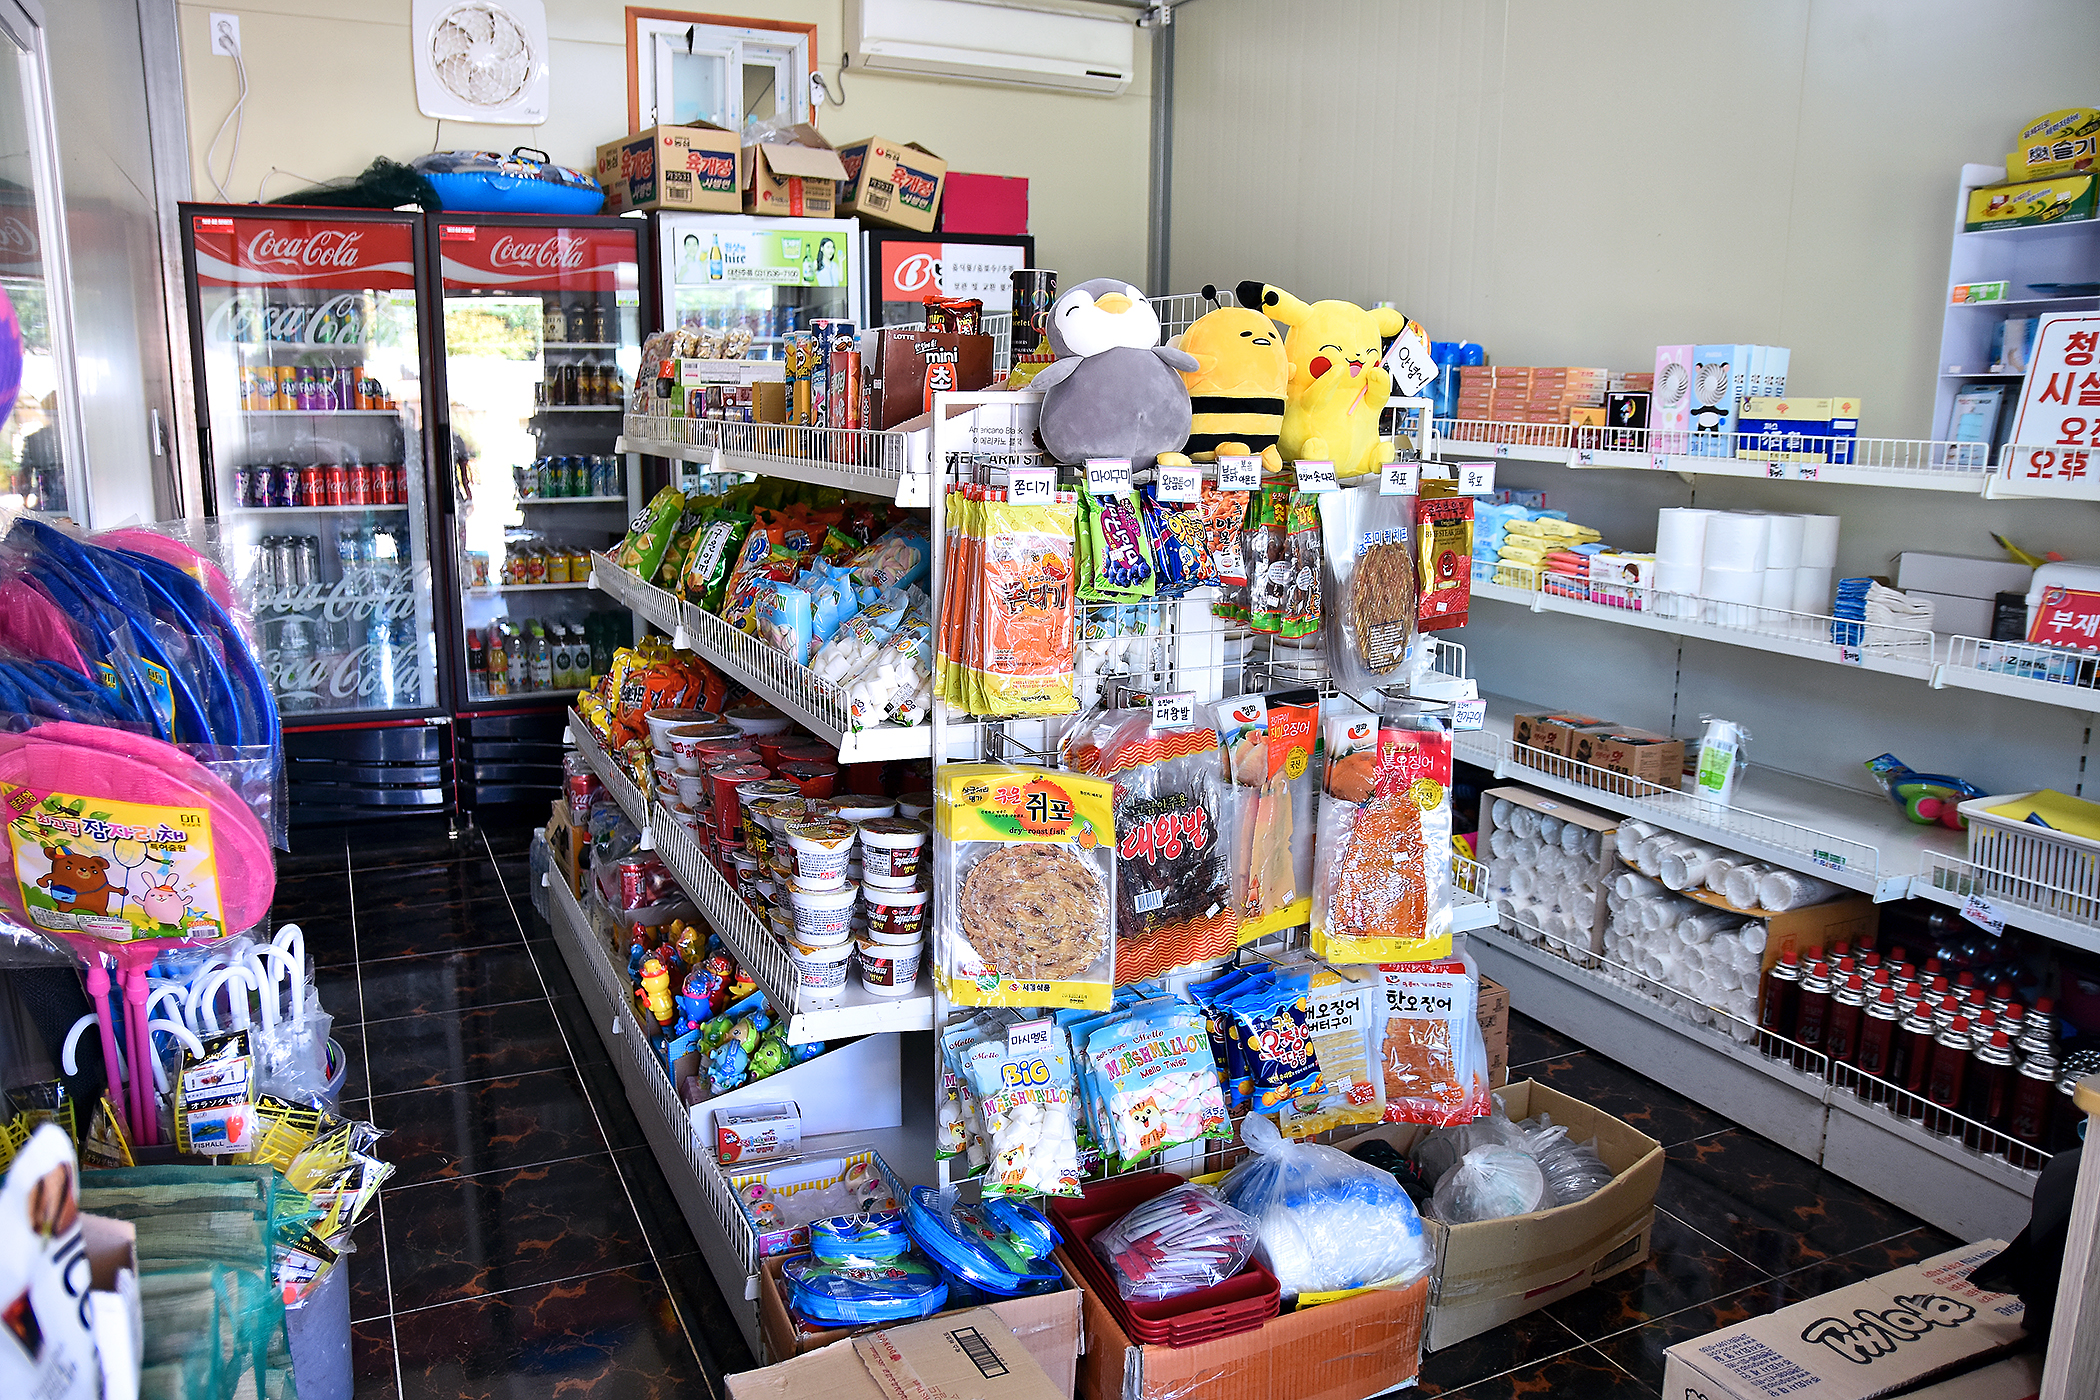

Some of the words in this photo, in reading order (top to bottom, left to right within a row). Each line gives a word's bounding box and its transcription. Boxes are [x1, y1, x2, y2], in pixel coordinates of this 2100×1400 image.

[621, 147, 653, 181] 육개장
[686, 151, 734, 178] 육개장
[702, 178, 731, 191] 사발면
[890, 166, 935, 198] 육개장
[248, 229, 364, 268] Coca-Cola
[490, 235, 589, 269] Coca-Cola
[893, 333, 915, 341] LOTTE
[926, 346, 959, 364] mini
[2027, 450, 2090, 481] 오후
[1091, 468, 1132, 484] 마이구미
[1161, 474, 1195, 491] 왕꿈틀이
[1314, 472, 1336, 484] 숏다리
[1390, 471, 1407, 486] 쥐포
[1467, 471, 1484, 487] 육포
[1014, 480, 1051, 497] 쫀디기
[1157, 706, 1191, 722] 대왕발
[1026, 792, 1073, 824] 쥐포
[36, 810, 80, 836] 최고급
[83, 818, 189, 844] 잠자리채
[1119, 804, 1210, 866] 대왕발
[1386, 989, 1452, 1013] 핫오징어
[1272, 1012, 1295, 1031] 구운
[1010, 1030, 1048, 1046] 마시멜로
[1105, 1032, 1209, 1082] MARSHMALLOW
[1139, 1064, 1162, 1080] Mello
[1163, 1056, 1188, 1072] Twist
[193, 1141, 225, 1149] FISHALL
